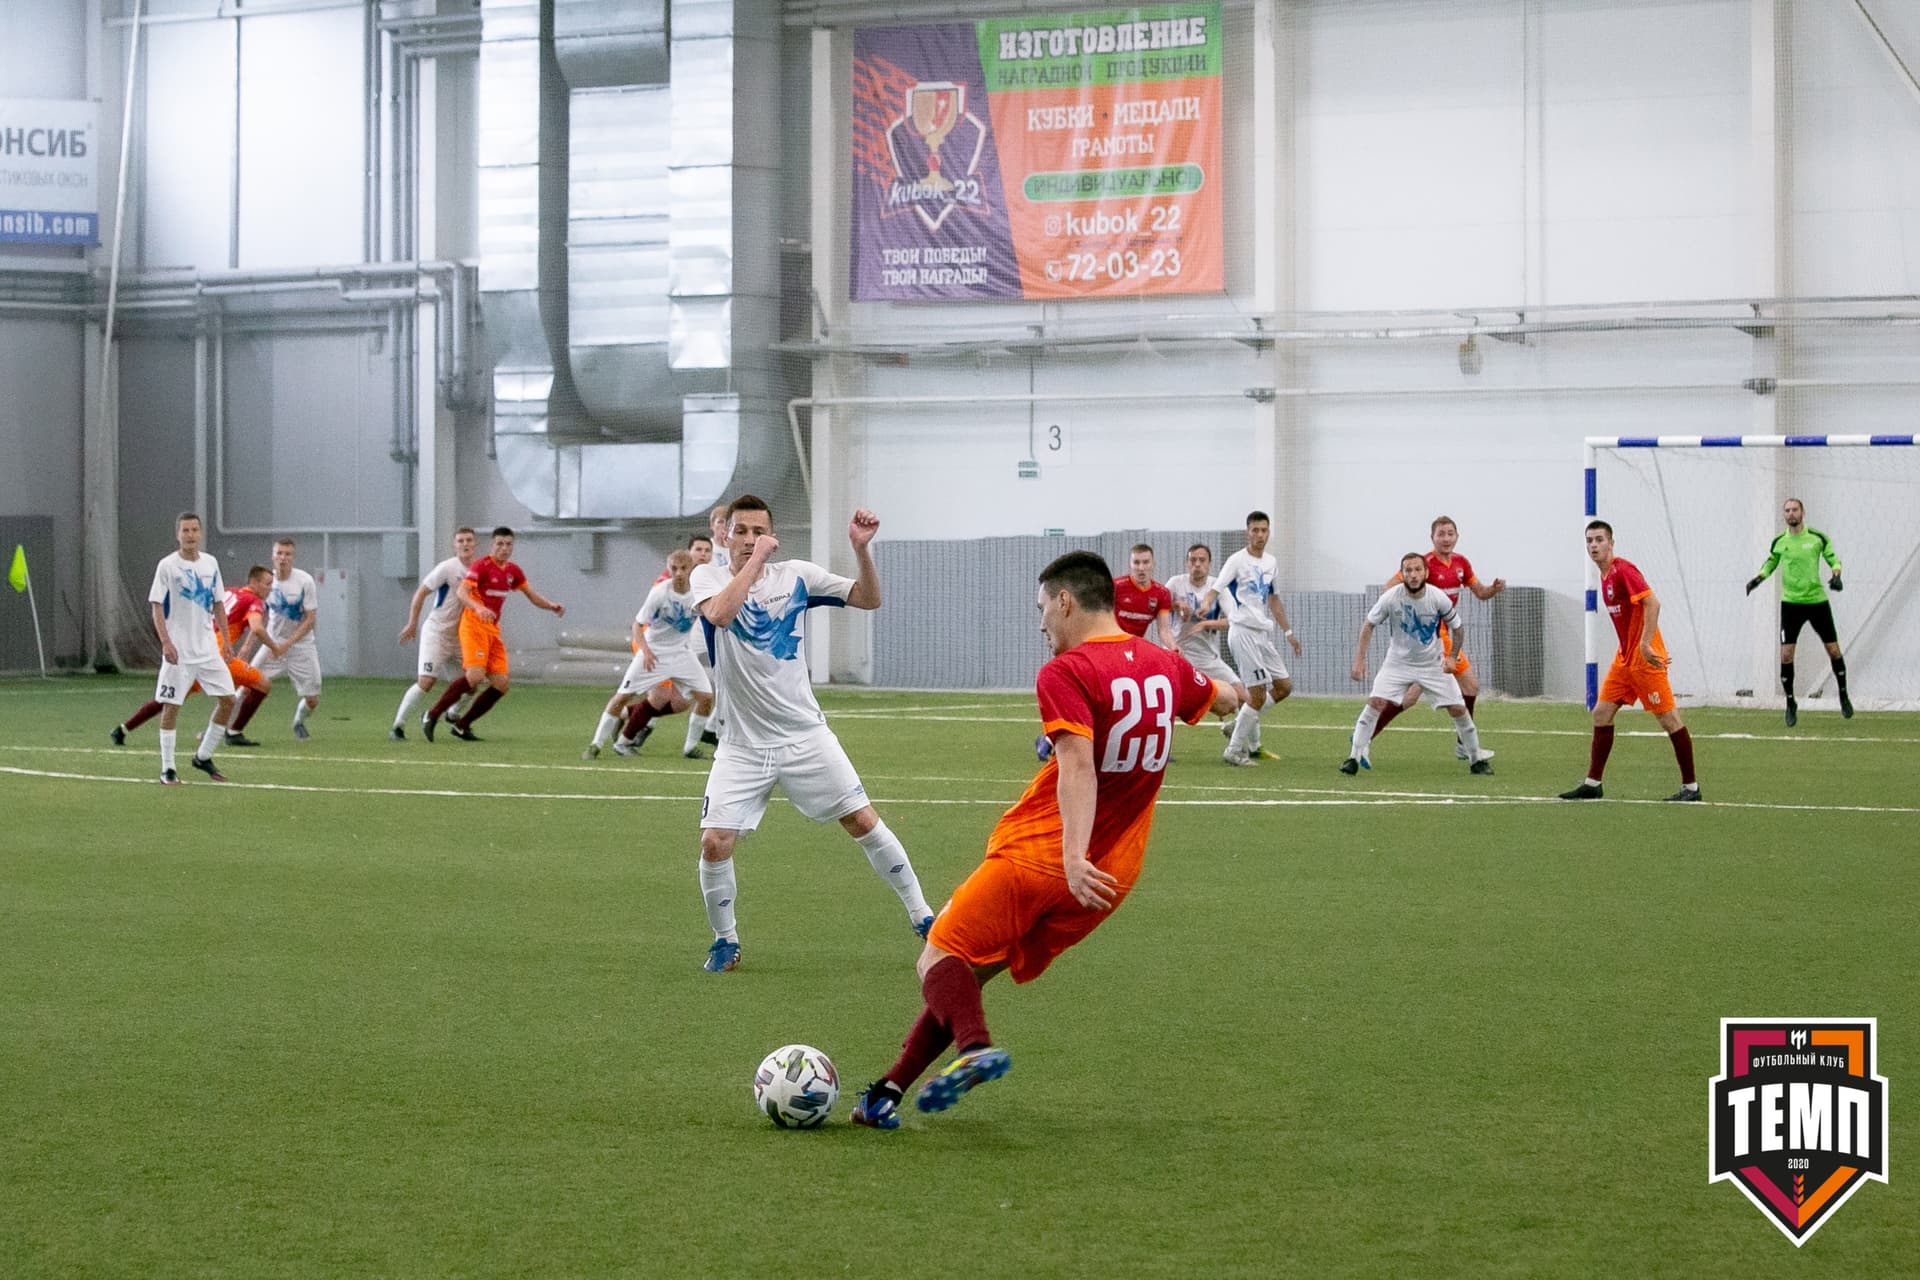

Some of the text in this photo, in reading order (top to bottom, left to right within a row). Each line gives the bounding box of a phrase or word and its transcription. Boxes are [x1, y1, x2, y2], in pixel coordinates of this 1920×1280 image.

[999, 16, 1206, 60] ИЗГОТОВЛЕНИЕ
[1106, 54, 1208, 79] ПРОДУКЦИИ
[1027, 97, 1200, 131] КУБКИ МЕДАЛИ
[0, 127, 87, 158] НСИБ
[1072, 133, 1154, 158] ГРАМОТЫ
[0, 212, 89, 236] nsib.com
[1065, 204, 1181, 236] kubok_22
[882, 247, 987, 265] ТВОИ ПОБЕДЫ!
[1067, 248, 1181, 281] 72-03-23
[882, 268, 987, 285] ТВОИ НАГРАДЫ!
[1049, 425, 1062, 451] 3
[1253, 669, 1266, 681] 11
[160, 685, 176, 699] 23
[1101, 674, 1174, 773] 23
